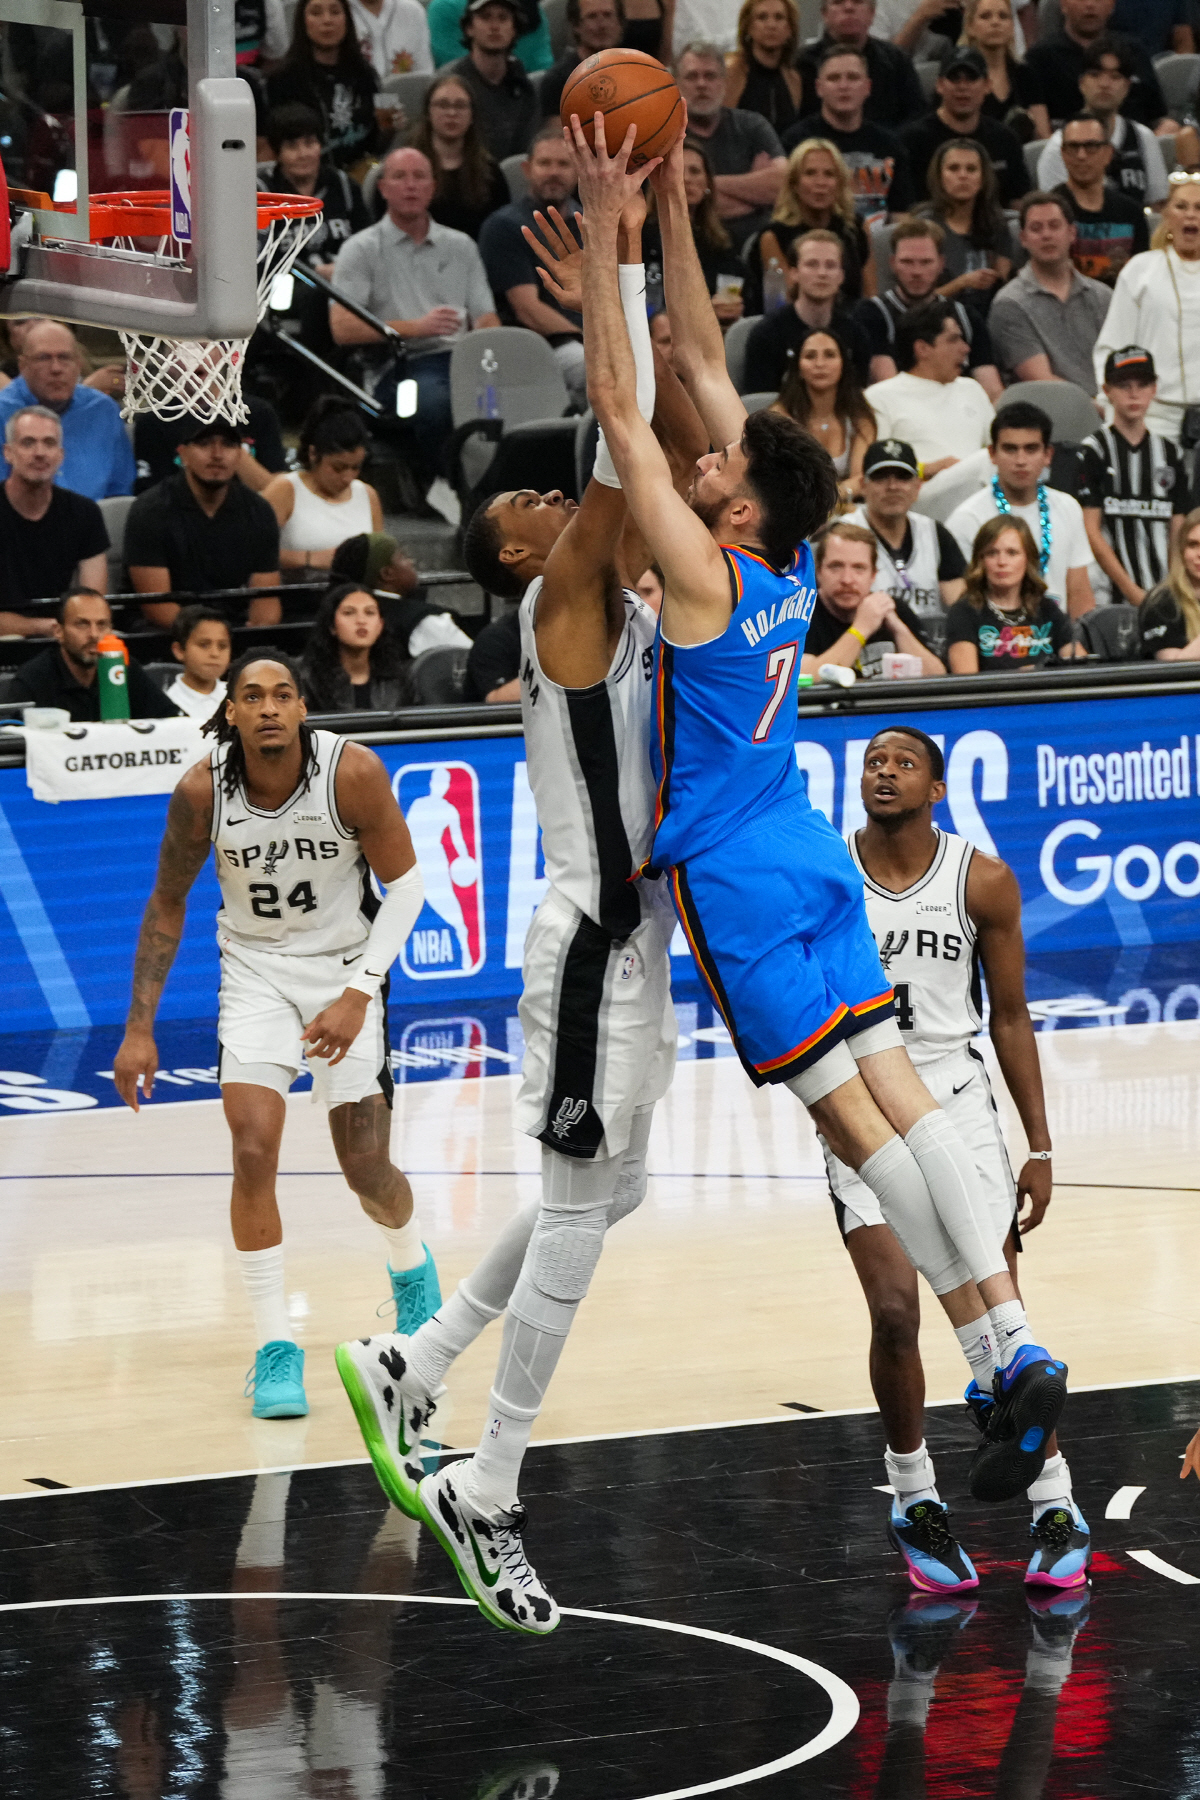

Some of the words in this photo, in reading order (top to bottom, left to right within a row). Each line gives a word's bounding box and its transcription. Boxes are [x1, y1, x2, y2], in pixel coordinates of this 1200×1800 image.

[174, 211, 190, 234] NBA
[108, 664, 126, 686] G
[752, 640, 799, 745] 7
[65, 748, 183, 772] GATORADE
[1036, 734, 1190, 808] Presented
[297, 814, 322, 822] LEDGER
[223, 838, 340, 876] SPURS
[1039, 818, 1200, 906] Goo
[248, 880, 318, 919] 24
[920, 904, 948, 912] LEDGER
[413, 929, 454, 965] NBA
[872, 929, 962, 970] URS
[893, 982, 916, 1033] 4
